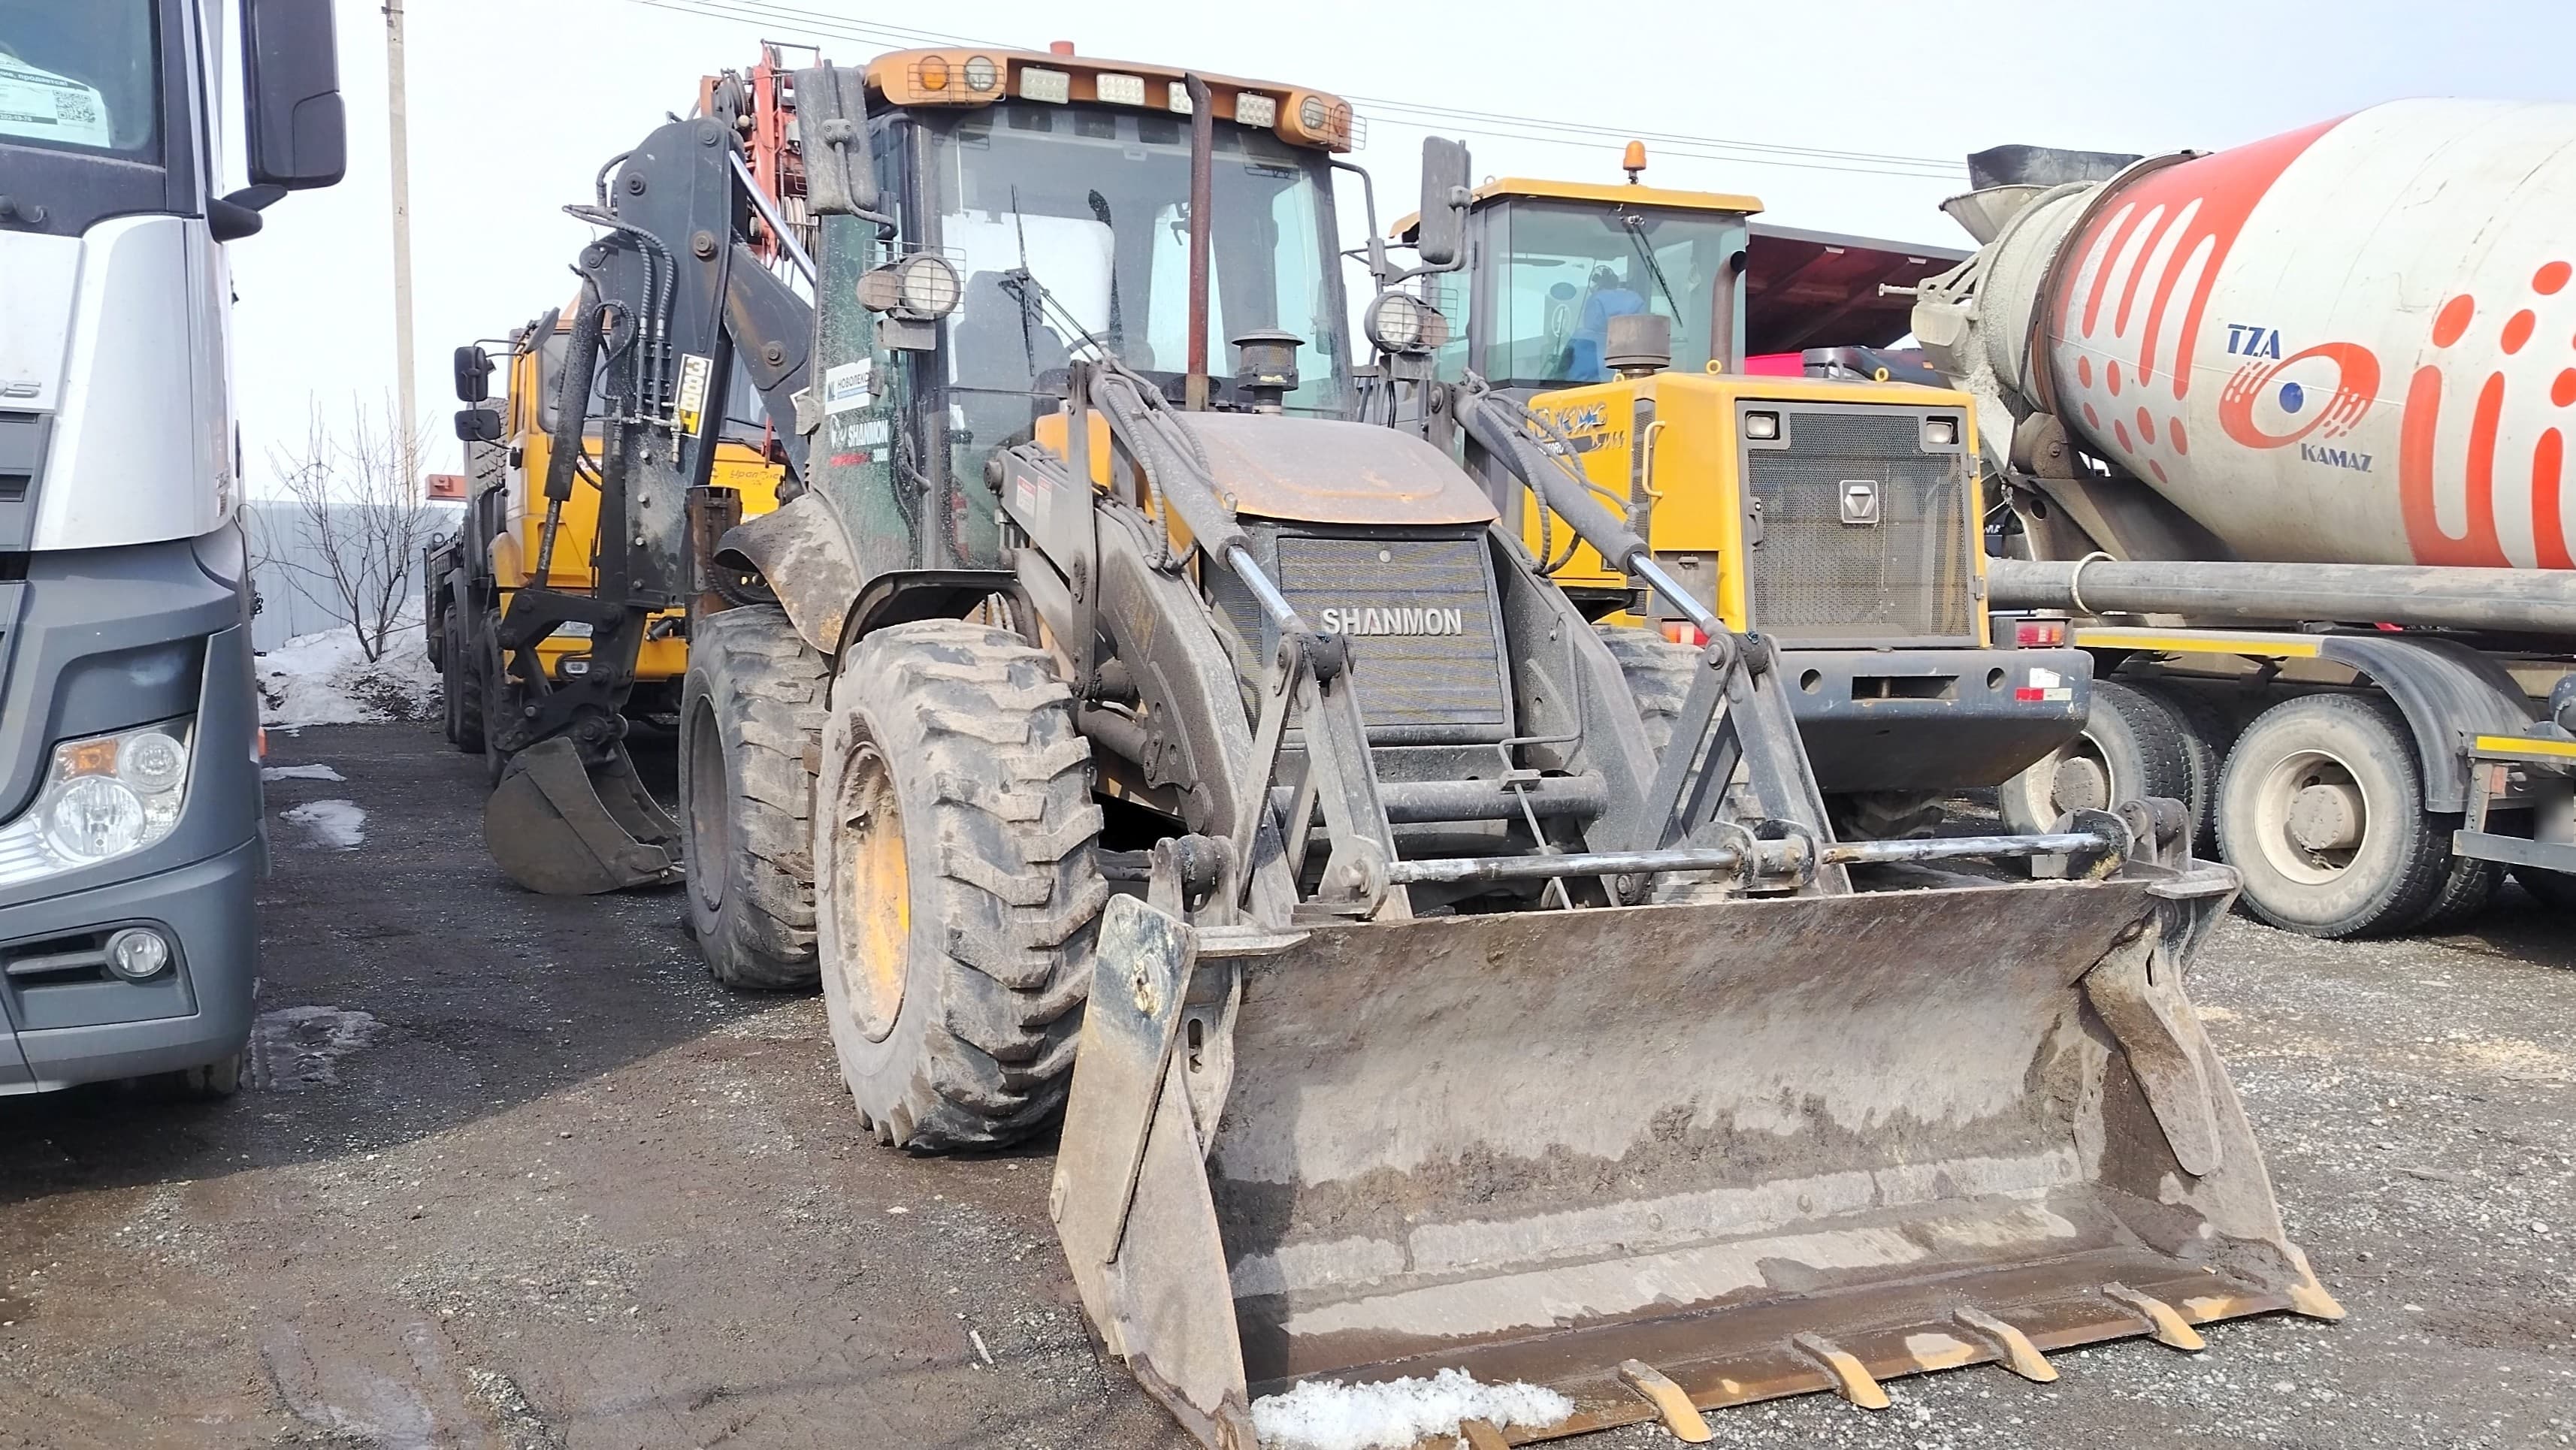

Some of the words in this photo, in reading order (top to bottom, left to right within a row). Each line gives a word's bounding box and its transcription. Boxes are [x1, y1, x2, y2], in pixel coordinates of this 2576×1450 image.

[2227, 324, 2281, 360] TZA
[848, 419, 888, 448] SHANMON
[2301, 443, 2374, 473] KAMAZ
[1321, 608, 1462, 636] SHANMON
